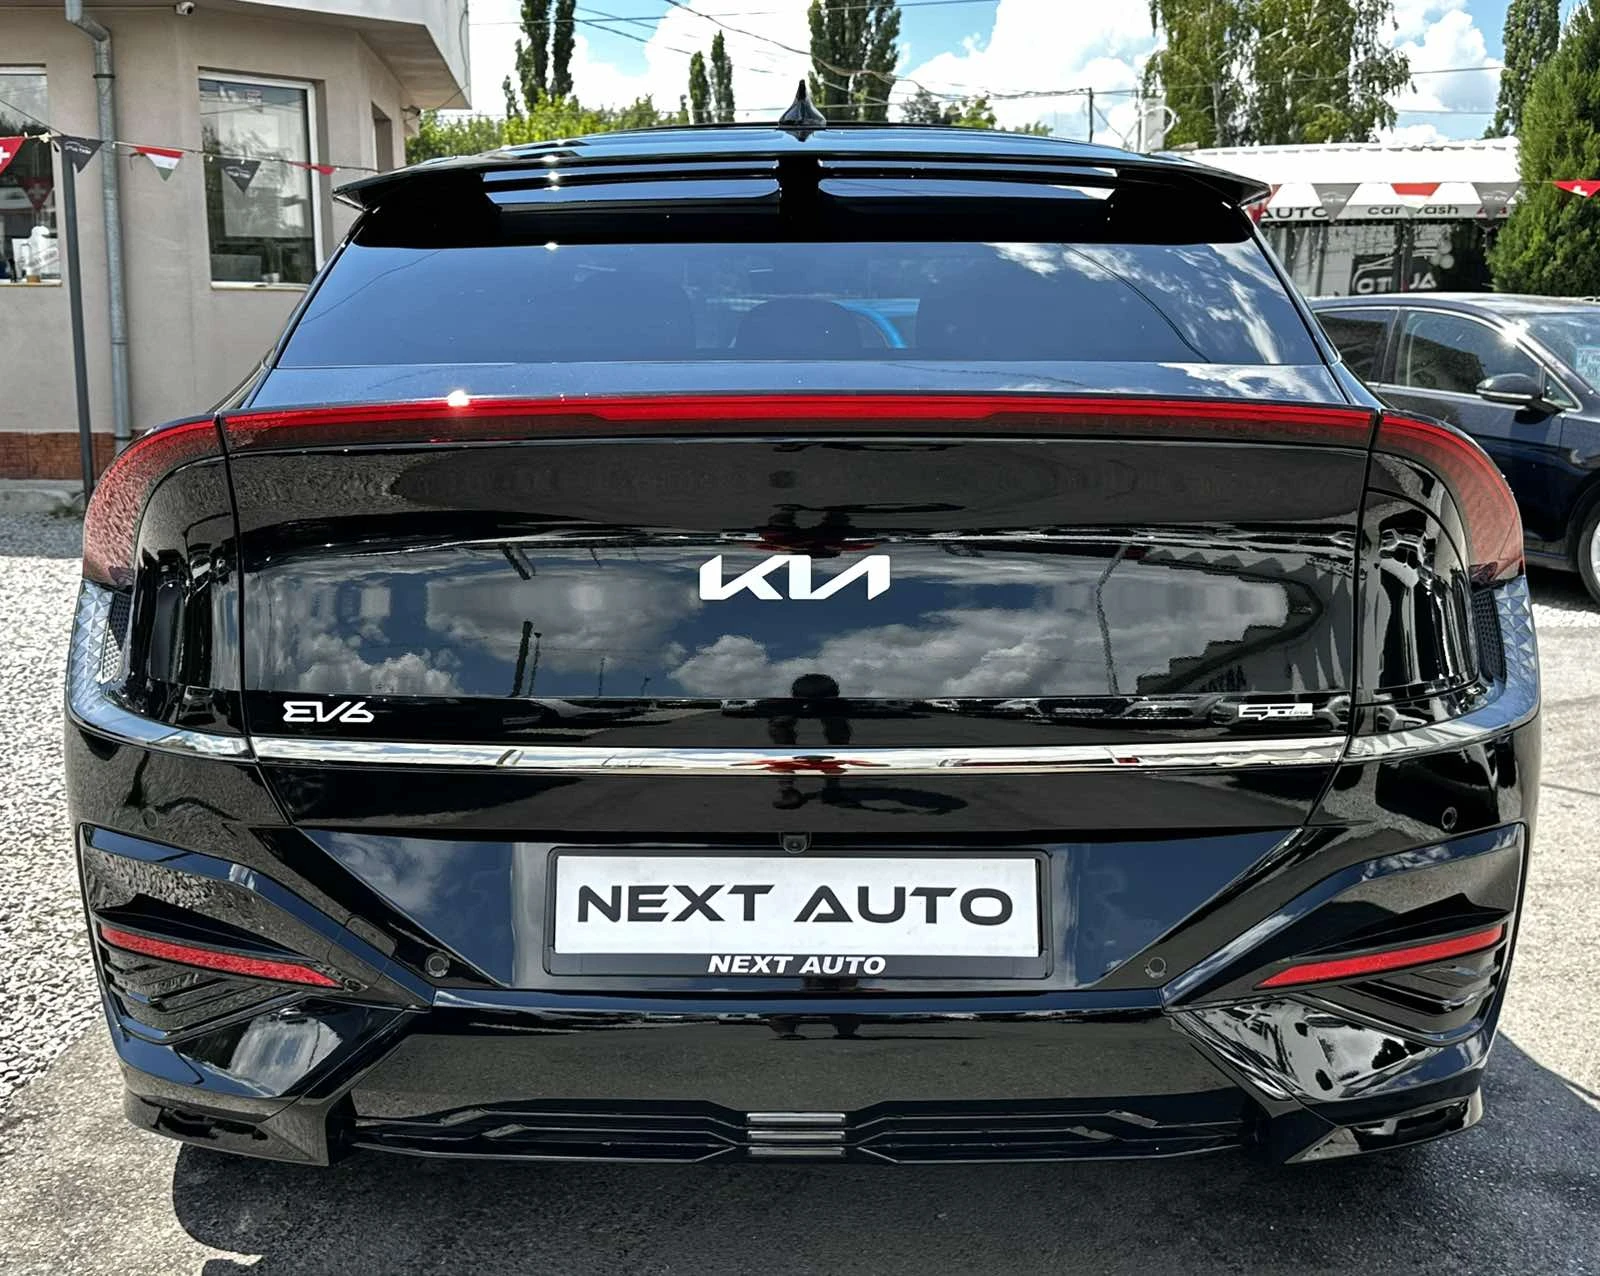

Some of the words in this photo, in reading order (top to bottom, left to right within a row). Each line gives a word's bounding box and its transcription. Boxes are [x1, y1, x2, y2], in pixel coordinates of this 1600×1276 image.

[1367, 205, 1401, 215] car
[699, 554, 891, 601] KIA
[282, 701, 375, 723] EV6
[577, 884, 775, 923] NEXT
[793, 884, 1014, 926] AUTO
[708, 955, 794, 974] NEXT
[799, 956, 886, 975] AUTO
